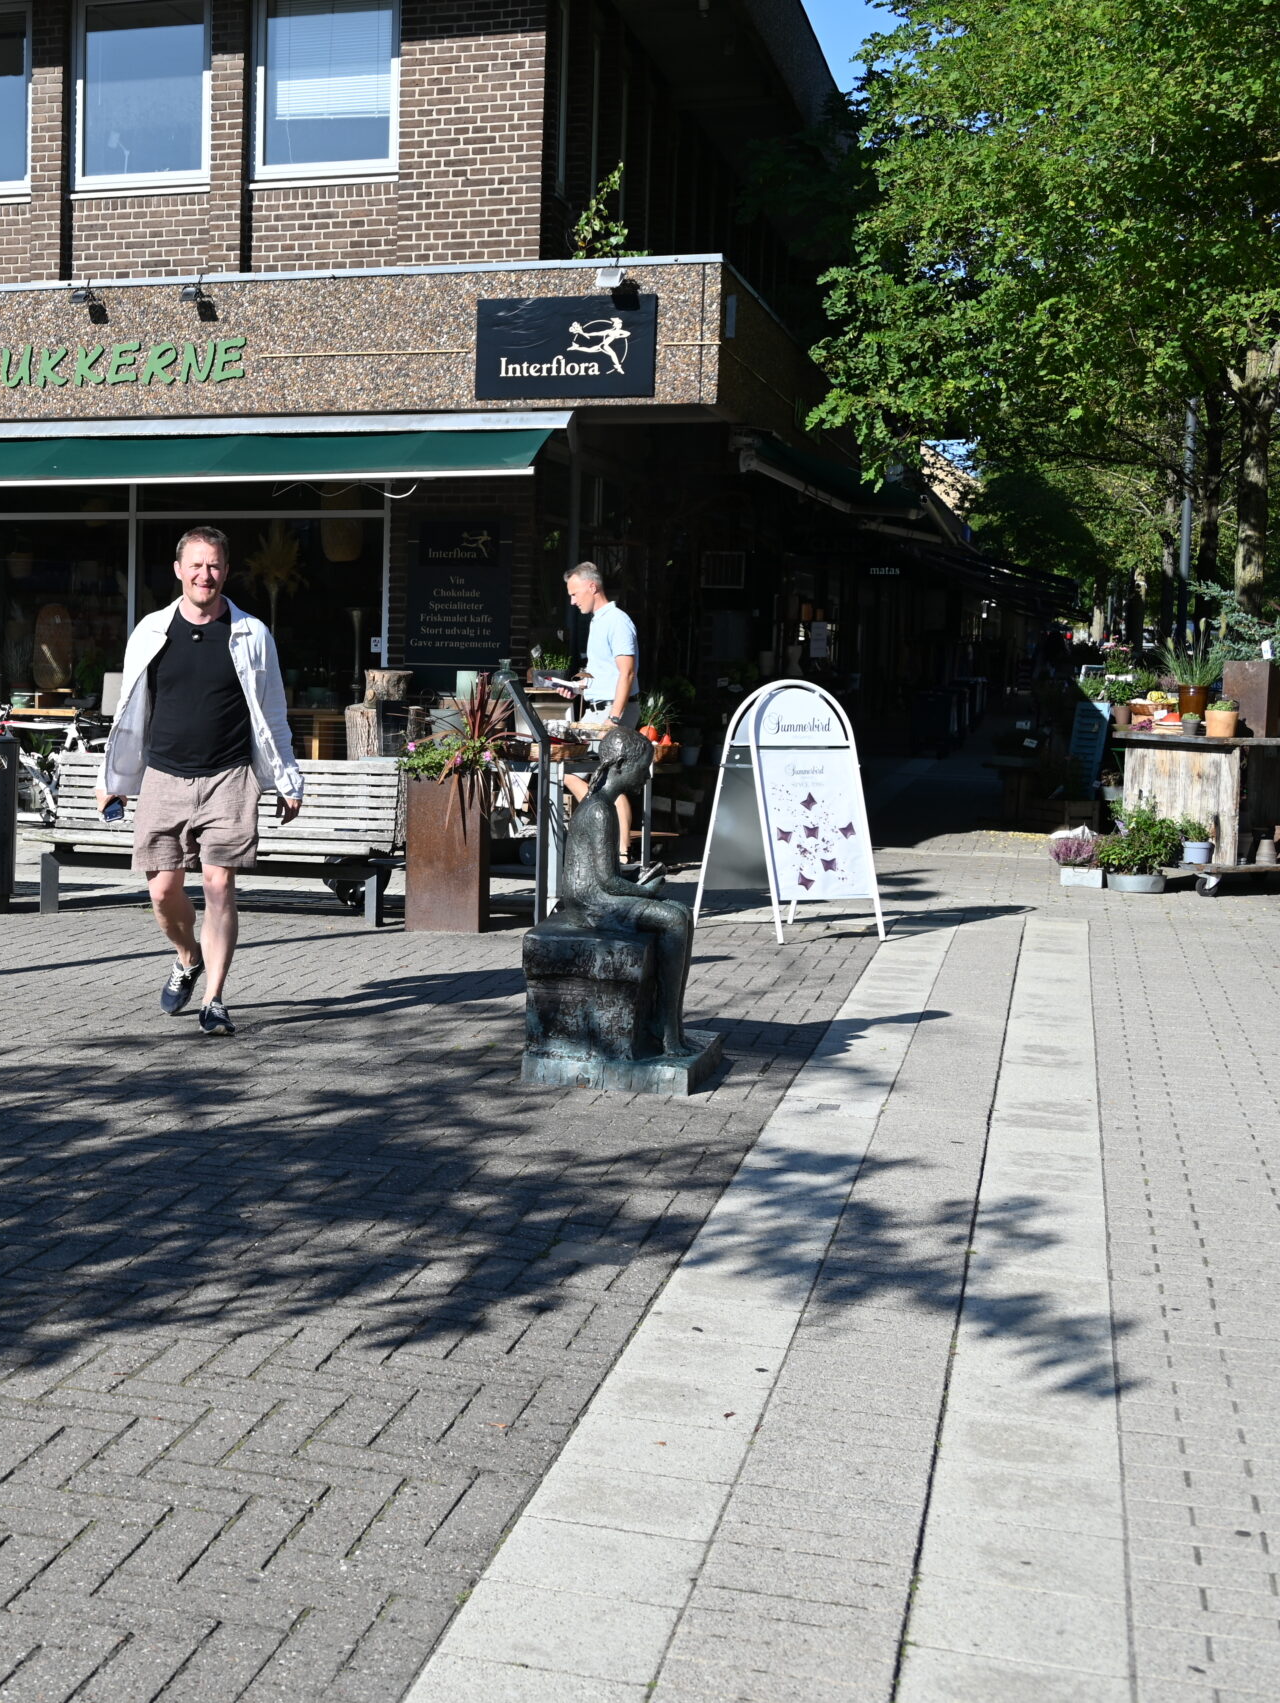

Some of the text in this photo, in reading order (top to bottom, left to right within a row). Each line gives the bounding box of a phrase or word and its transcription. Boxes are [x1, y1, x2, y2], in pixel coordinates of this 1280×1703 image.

[499, 354, 601, 377] Interflora
[428, 547, 477, 559] Interflora
[869, 566, 901, 576] matas
[449, 576, 465, 585] Vin
[433, 588, 481, 598] Chokolade
[429, 600, 485, 611] Specialiteter
[420, 613, 494, 623] Friskmalet kaffe
[420, 626, 443, 635] Stort
[445, 626, 475, 637] udvalg
[483, 627, 492, 636] te
[410, 638, 502, 650] Gave arrangementer
[763, 711, 832, 736] Summerbird
[784, 762, 825, 777] Summerbird
